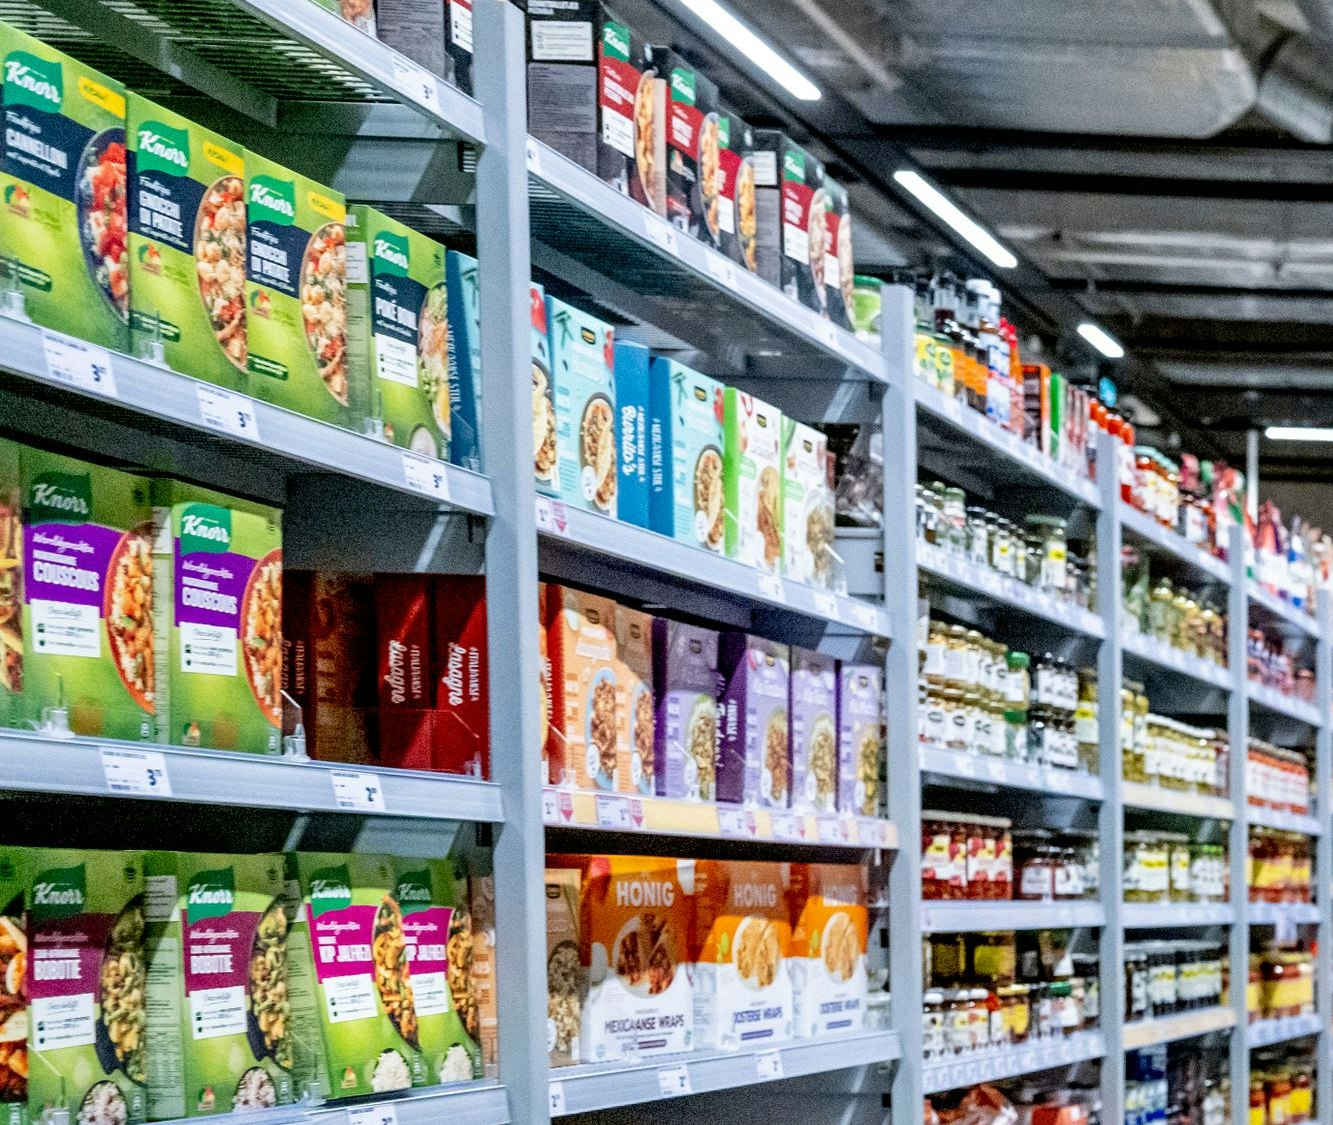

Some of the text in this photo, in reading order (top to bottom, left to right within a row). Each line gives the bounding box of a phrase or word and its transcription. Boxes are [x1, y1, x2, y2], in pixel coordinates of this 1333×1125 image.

[5, 60, 61, 104] Knorr
[138, 130, 189, 169] Knorr
[250, 182, 294, 218] Knorr
[32, 482, 90, 515] Knorr
[181, 514, 231, 544] Knorr
[616, 880, 675, 908] HONIG
[733, 882, 777, 908] HONIG
[821, 883, 858, 908] HONIG
[604, 1013, 685, 1034] MEXICAANSE WRAPS
